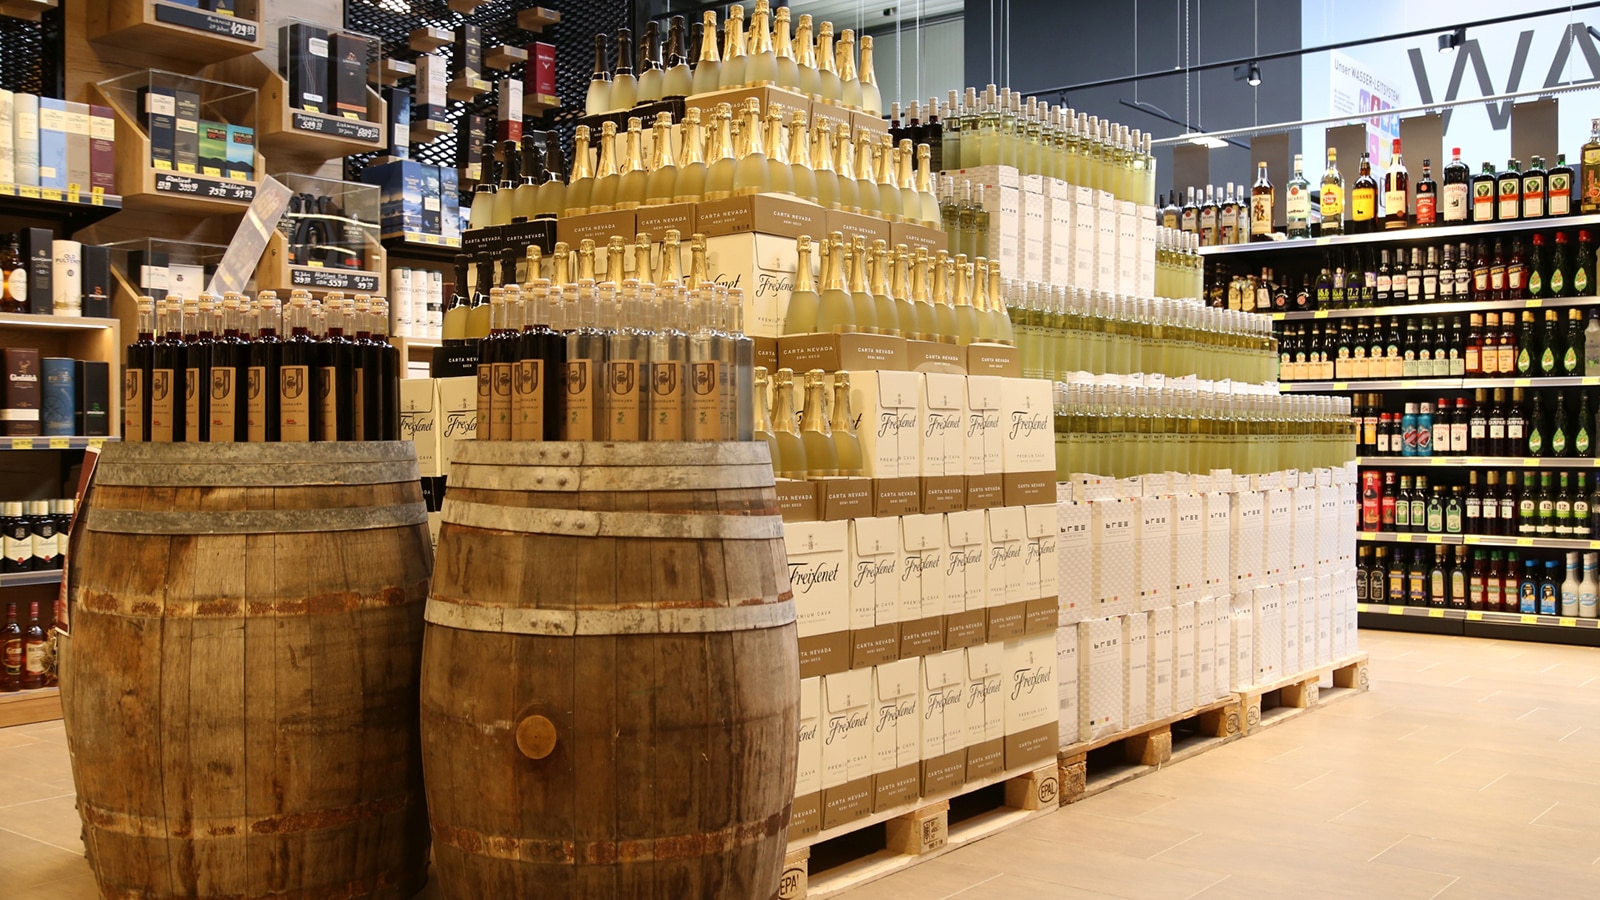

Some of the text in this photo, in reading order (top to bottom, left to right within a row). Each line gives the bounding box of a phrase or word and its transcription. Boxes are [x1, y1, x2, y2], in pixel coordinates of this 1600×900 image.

[1334, 57, 1350, 76] Unser
[663, 216, 687, 224] NEVADA
[700, 208, 748, 220] CARTA NEVADA
[773, 210, 811, 222] CARTA NEVADA
[843, 224, 877, 235] CARTA NEVADA
[906, 235, 936, 245] CARTA NEVADA
[877, 412, 917, 438] Freixenet
[925, 413, 961, 438] Freixenet
[967, 414, 1000, 438] Freixenet
[1009, 411, 1048, 440] Freixenet
[1243, 509, 1260, 517] bree
[1060, 524, 1086, 533] bree
[1105, 521, 1128, 529] bree
[946, 549, 982, 576] Freixenet
[989, 545, 1021, 571] Freixenet
[854, 560, 896, 588] Freixenet
[902, 554, 940, 582] Freixenet
[787, 562, 839, 594] Freixenet
[809, 647, 832, 656] NEVADA
[1094, 639, 1117, 649] bree
[1010, 666, 1052, 701] Freixenet
[967, 680, 1001, 709] Freixenet
[925, 690, 962, 720] Freixenet
[876, 700, 916, 733] Freixenet
[825, 712, 869, 745] Freixenet
[1019, 736, 1048, 749] CARTA NEVADA
[985, 752, 1001, 760] NEVADA
[928, 764, 962, 778] CARTA NEVADA
[878, 777, 916, 792] CARTA NEVADA
[1041, 782, 1055, 799] EPAL
[828, 792, 868, 808] CARTA NEVADA
[793, 809, 816, 819] NEVADA
